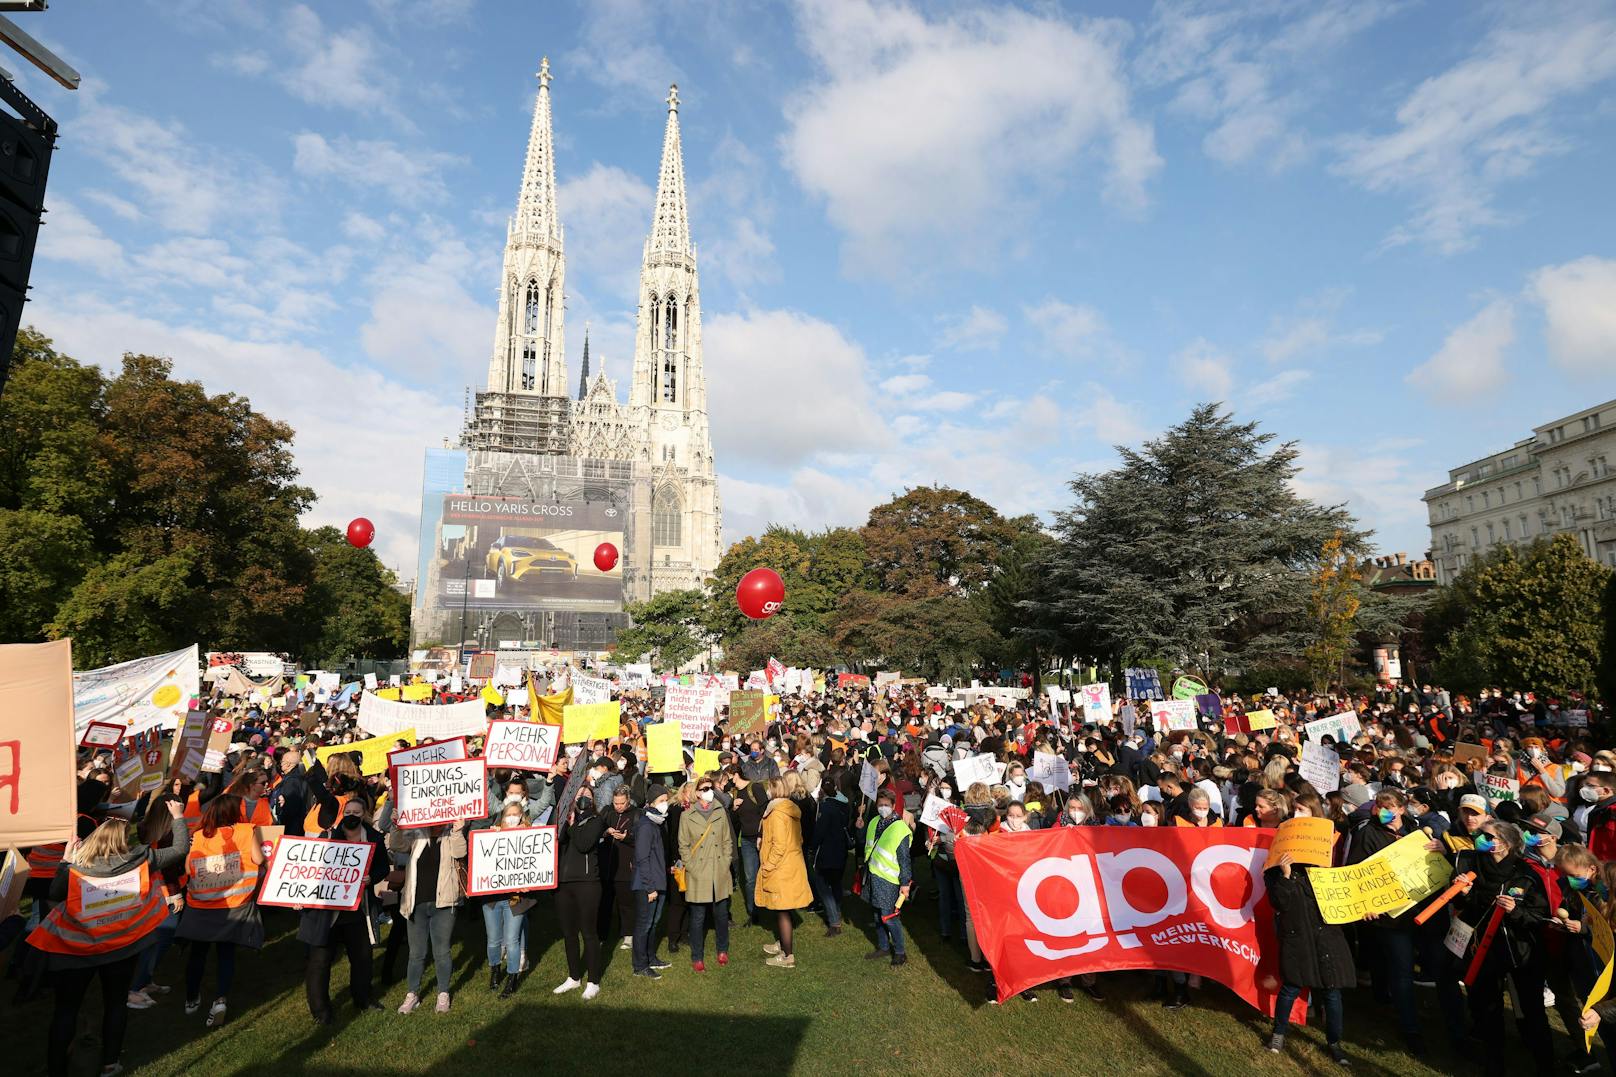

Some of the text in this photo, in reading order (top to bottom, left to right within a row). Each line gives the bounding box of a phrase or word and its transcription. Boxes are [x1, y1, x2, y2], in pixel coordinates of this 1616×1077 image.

[451, 501, 491, 513] HELLO
[495, 503, 528, 514] YARIS
[532, 504, 573, 517] CROSS
[670, 695, 691, 704] nicht
[678, 687, 697, 696] kann
[699, 689, 712, 697] gar
[664, 712, 715, 723] arbeiten wie
[668, 703, 702, 714] schlecht
[503, 726, 548, 745] MEHR
[411, 746, 447, 764] MEHR
[489, 742, 552, 764] PERSONAL
[402, 766, 467, 787] BILDUNGS-
[411, 778, 482, 799] EINRICHTUNG
[397, 798, 482, 824] AUFBEWAHRUNG!!
[430, 796, 456, 808] KEINE
[480, 832, 552, 857] WENIGER
[286, 843, 363, 867] GLEICHES
[495, 856, 537, 872] KINDER
[279, 861, 361, 885] FÖRDERGELD
[1309, 870, 1325, 883] DIE
[1329, 861, 1385, 884] ZUKUNFT
[276, 881, 308, 899] FÜR
[308, 884, 340, 901] ALLE
[1314, 871, 1399, 901] EURER KINDER
[1017, 844, 1268, 960] gpa
[1321, 886, 1411, 920] KOSTET GELD!
[1151, 922, 1209, 941] MEINE
